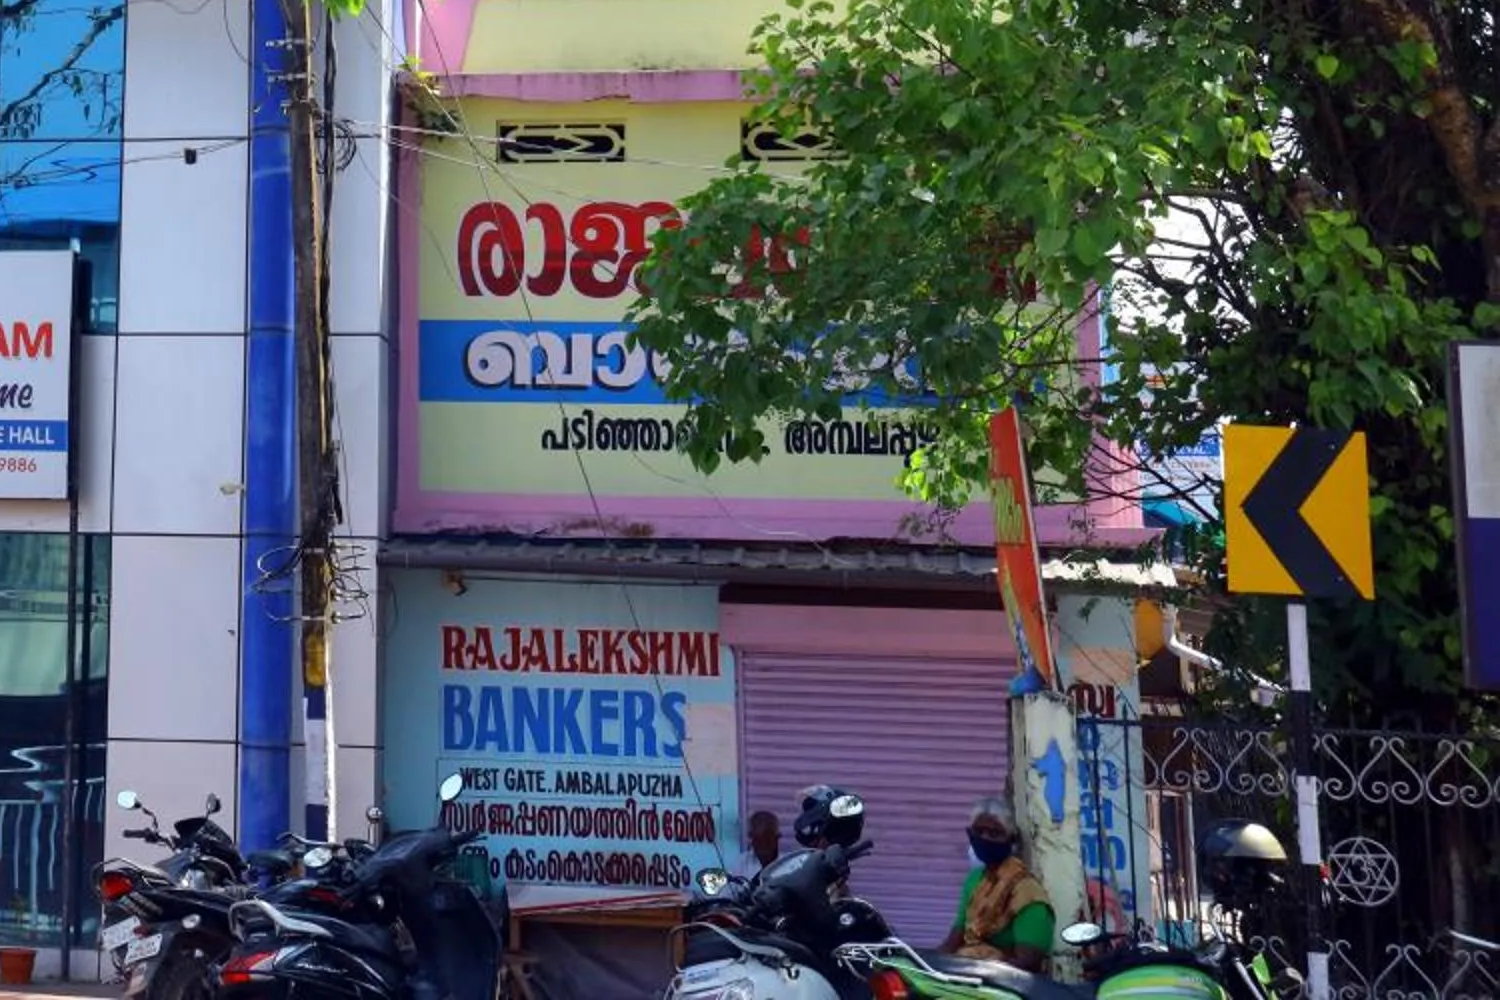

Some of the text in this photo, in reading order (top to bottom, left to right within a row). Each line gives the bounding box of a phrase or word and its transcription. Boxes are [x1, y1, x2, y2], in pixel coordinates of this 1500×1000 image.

[9, 426, 55, 445] HALL
[442, 625, 719, 677] RAJALEKSHMI
[443, 683, 687, 759] BANKERS
[460, 767, 499, 791] WEST
[555, 770, 683, 799] AMBALAPUZHA
